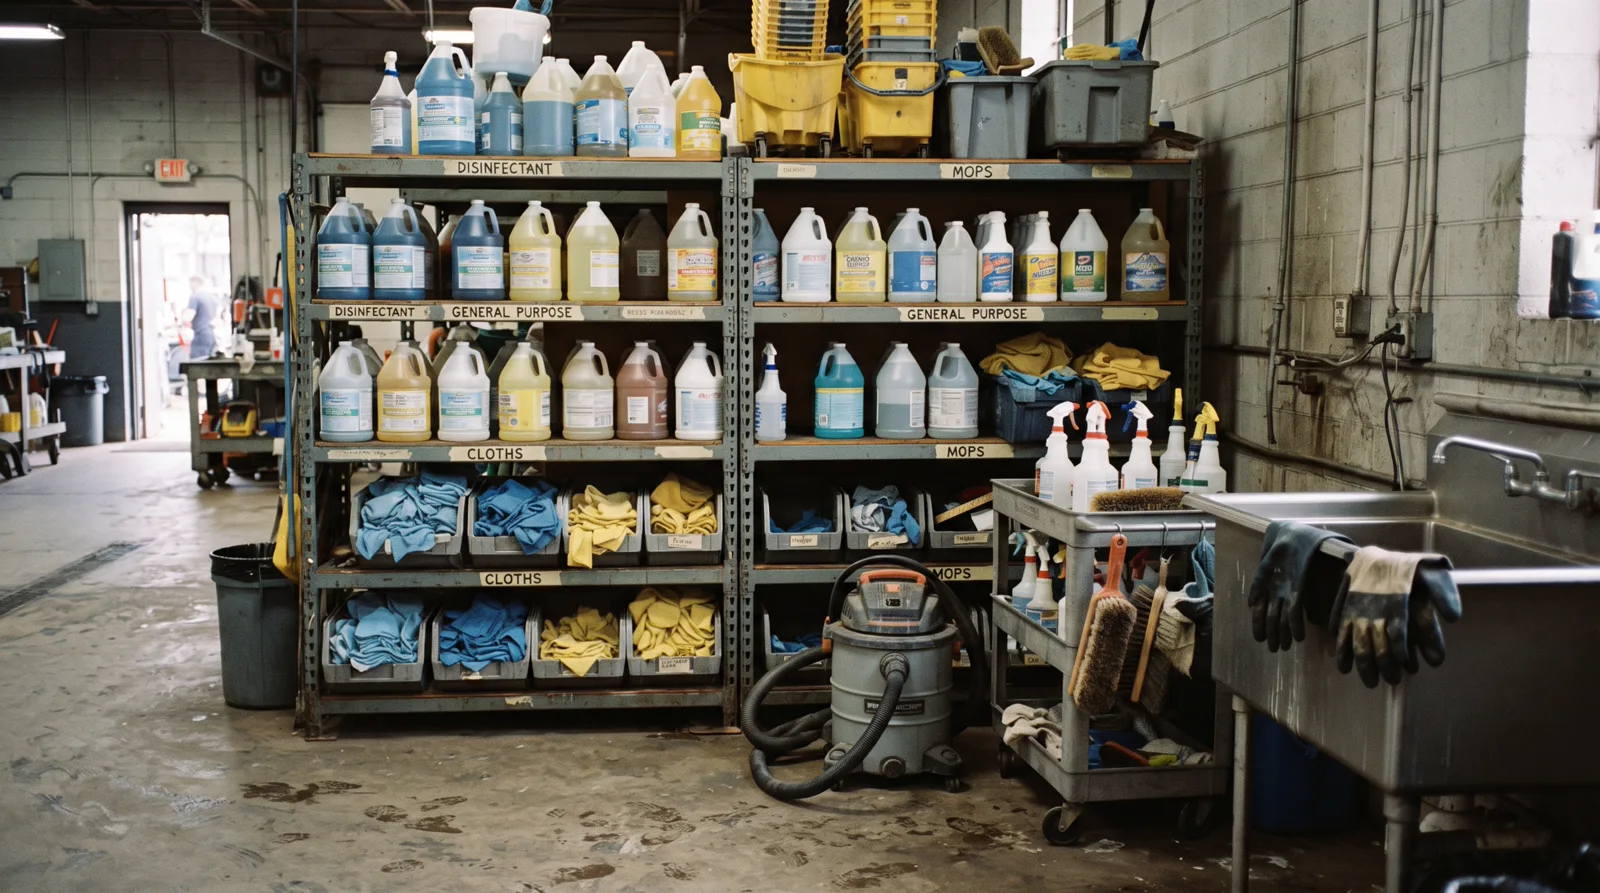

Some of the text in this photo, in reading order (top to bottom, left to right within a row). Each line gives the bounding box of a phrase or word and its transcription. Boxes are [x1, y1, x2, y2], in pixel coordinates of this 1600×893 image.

[160, 160, 185, 177] EXIT
[458, 161, 552, 175] DISINFECTANT
[953, 165, 993, 179] MOPS
[335, 306, 415, 317] DISINFECTANT
[452, 306, 572, 318] GENERAL PURPOSE
[907, 308, 1028, 320] GENERAL PURPOSE
[467, 447, 523, 460] CLOTHS
[947, 445, 985, 458] MOPS
[485, 572, 542, 585] CLOTHS
[932, 567, 972, 580] MOPS
